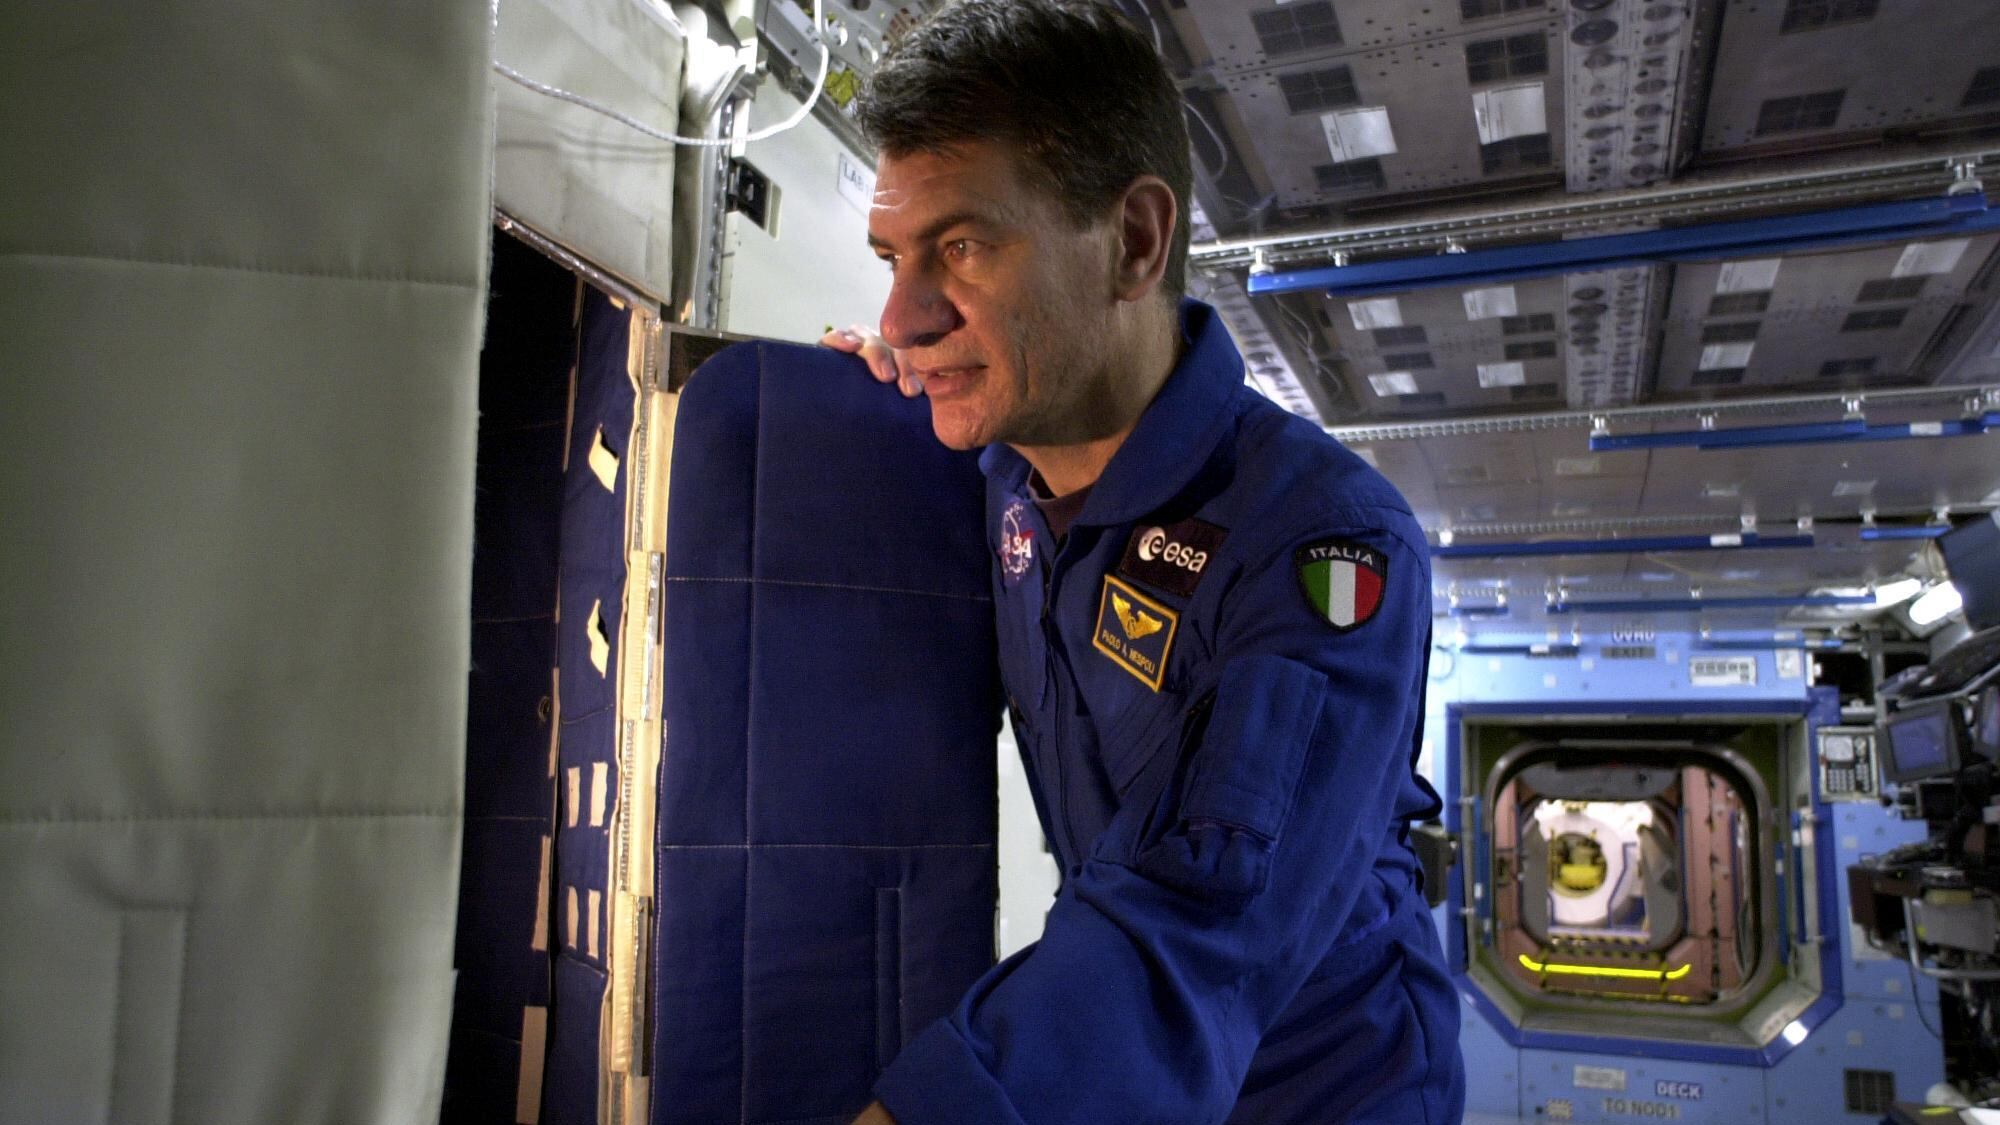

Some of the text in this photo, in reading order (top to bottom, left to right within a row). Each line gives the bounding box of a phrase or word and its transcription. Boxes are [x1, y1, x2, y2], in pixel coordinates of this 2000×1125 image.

[1001, 532, 1032, 558] ASA
[1309, 545, 1373, 566] ITALIA
[1102, 629, 1121, 650] PAOLO
[1129, 648, 1156, 675] NESPOLI
[1657, 1081, 1700, 1099] DECK
[1605, 1098, 1626, 1114] TO
